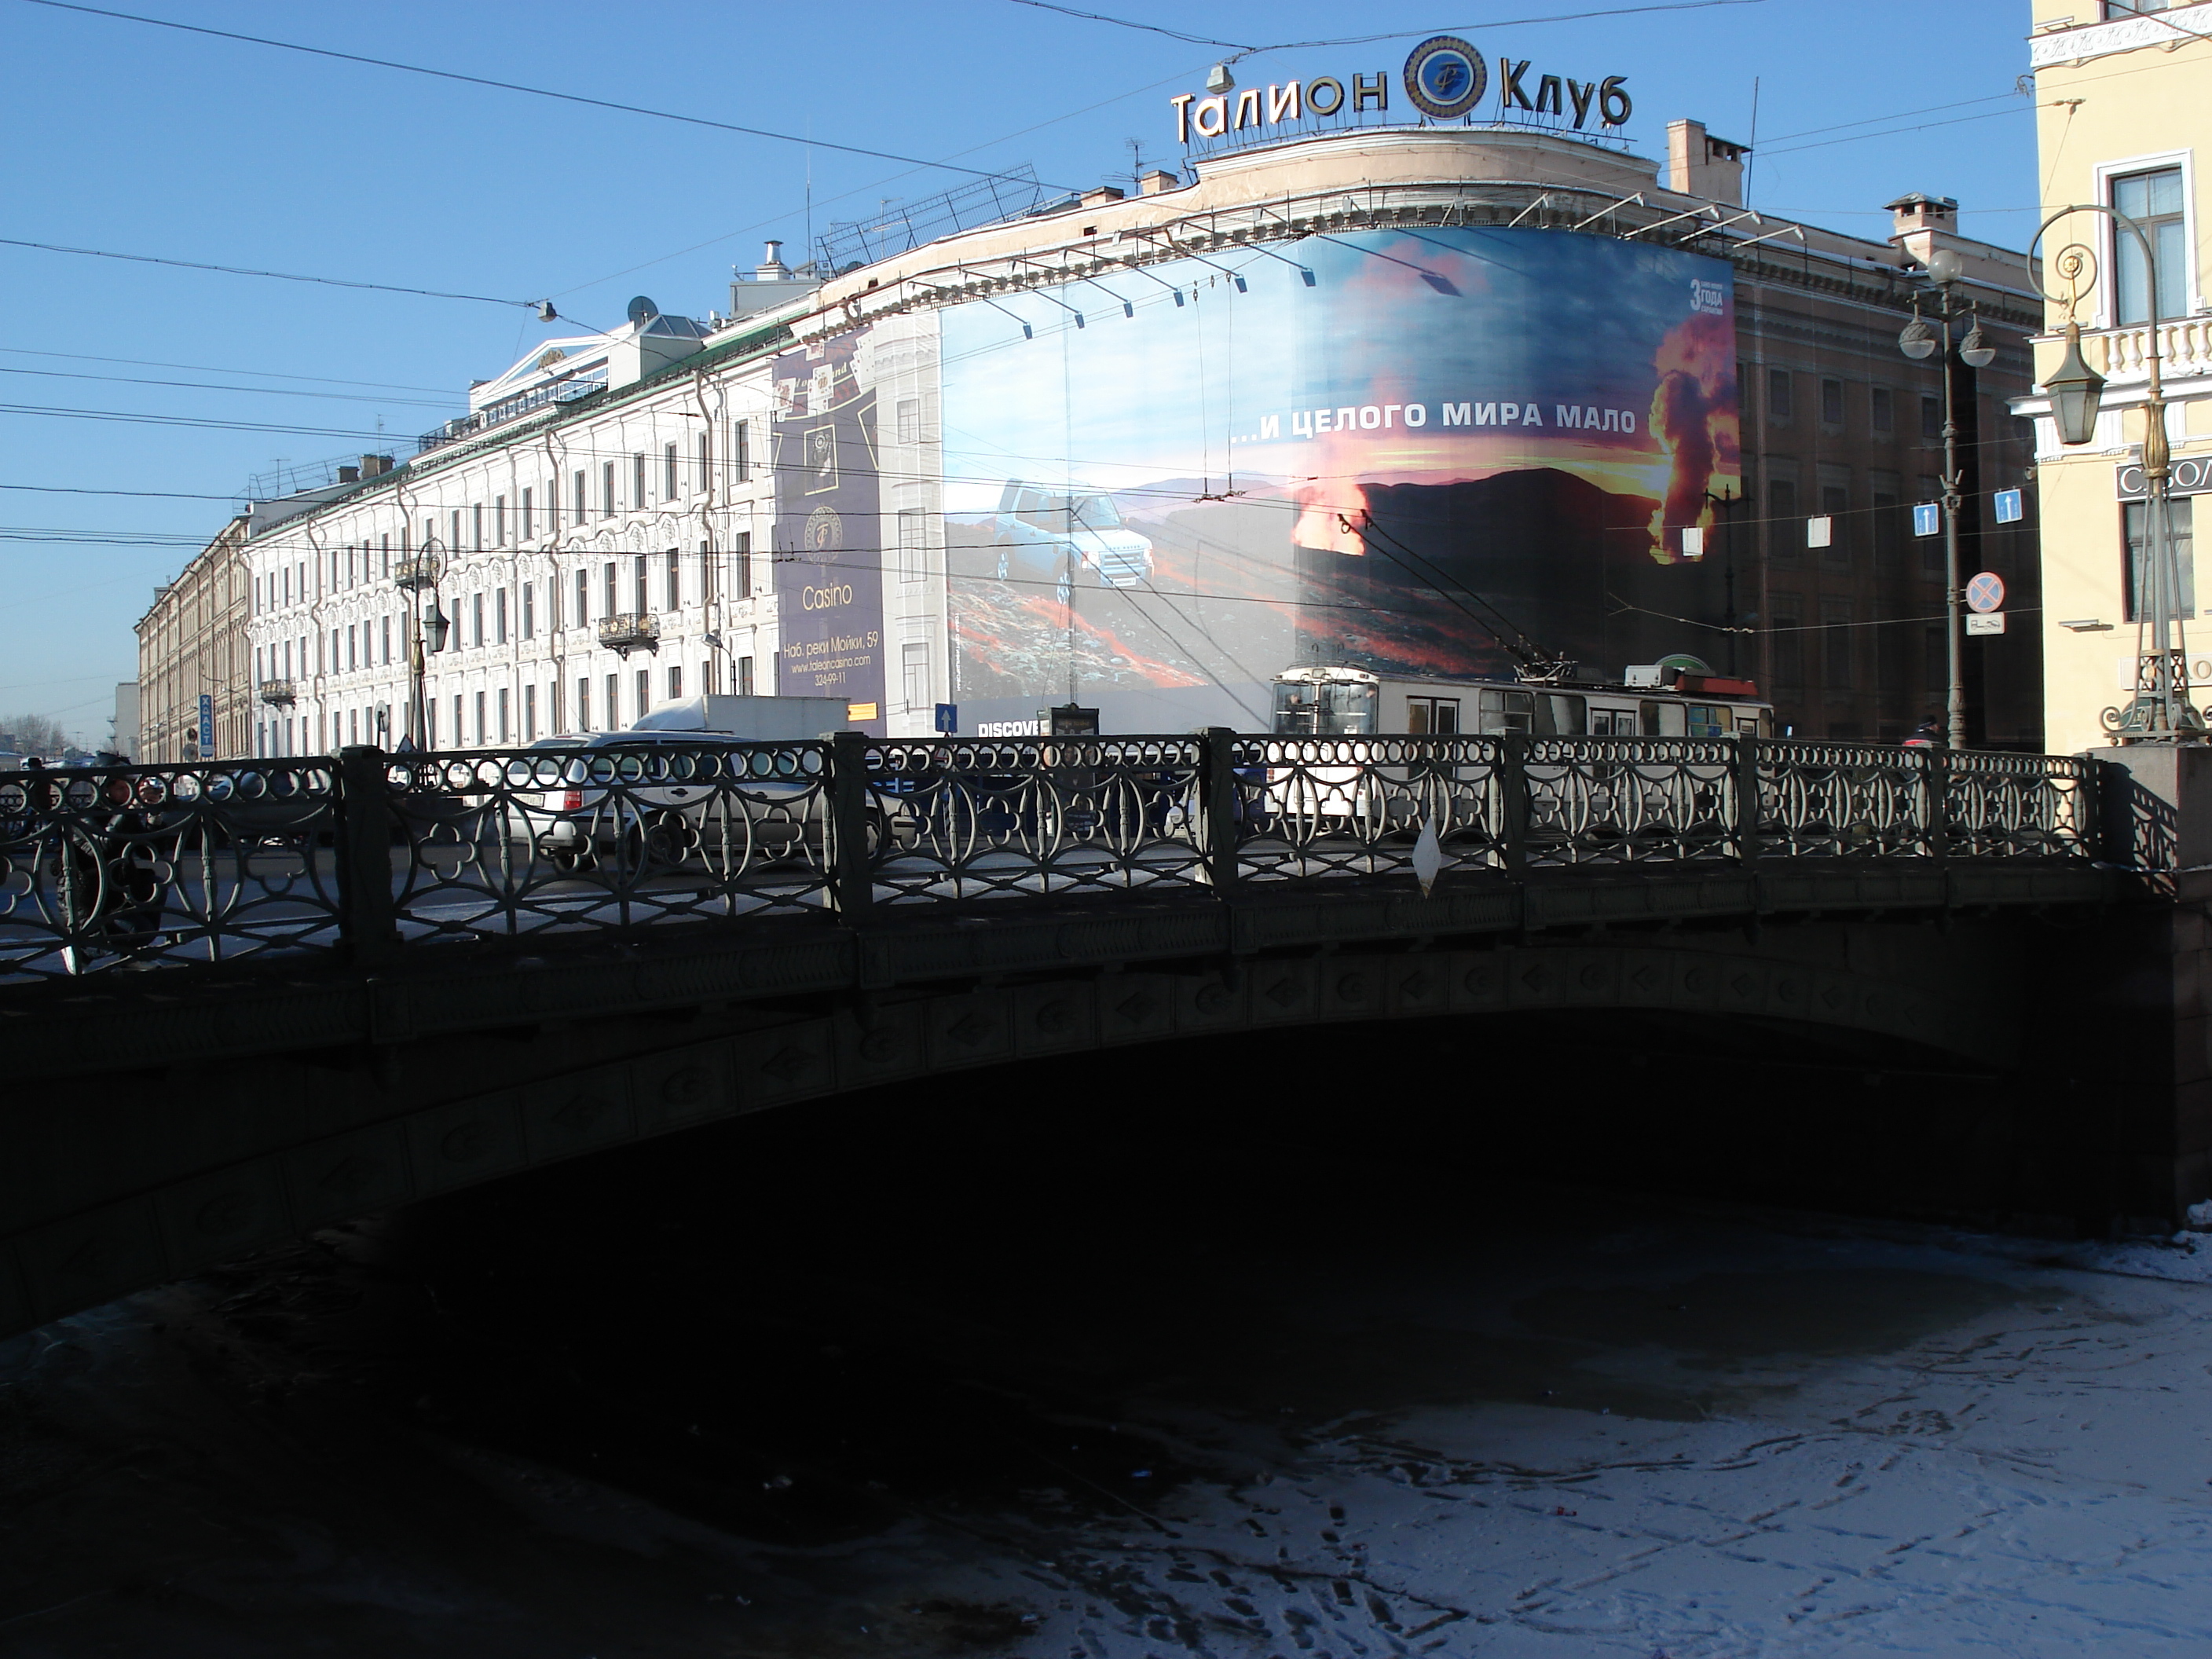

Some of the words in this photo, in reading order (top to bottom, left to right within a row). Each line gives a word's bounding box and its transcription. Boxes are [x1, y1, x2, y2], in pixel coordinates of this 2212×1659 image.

[1170, 71, 1388, 145] Талион
[1500, 57, 1632, 130] Клуб
[1690, 279, 1701, 311] 3
[1701, 289, 1723, 307] ГОДА
[1292, 403, 1426, 439] ЦЕЛОГО
[1442, 402, 1544, 427] МИРА
[1556, 404, 1636, 434] МАЛО
[803, 582, 853, 611] Casino
[784, 642, 804, 659] Наб.
[806, 640, 829, 659] реки
[830, 634, 866, 654] Мойки,
[866, 631, 879, 649] 59
[815, 671, 846, 687] 324-99-11
